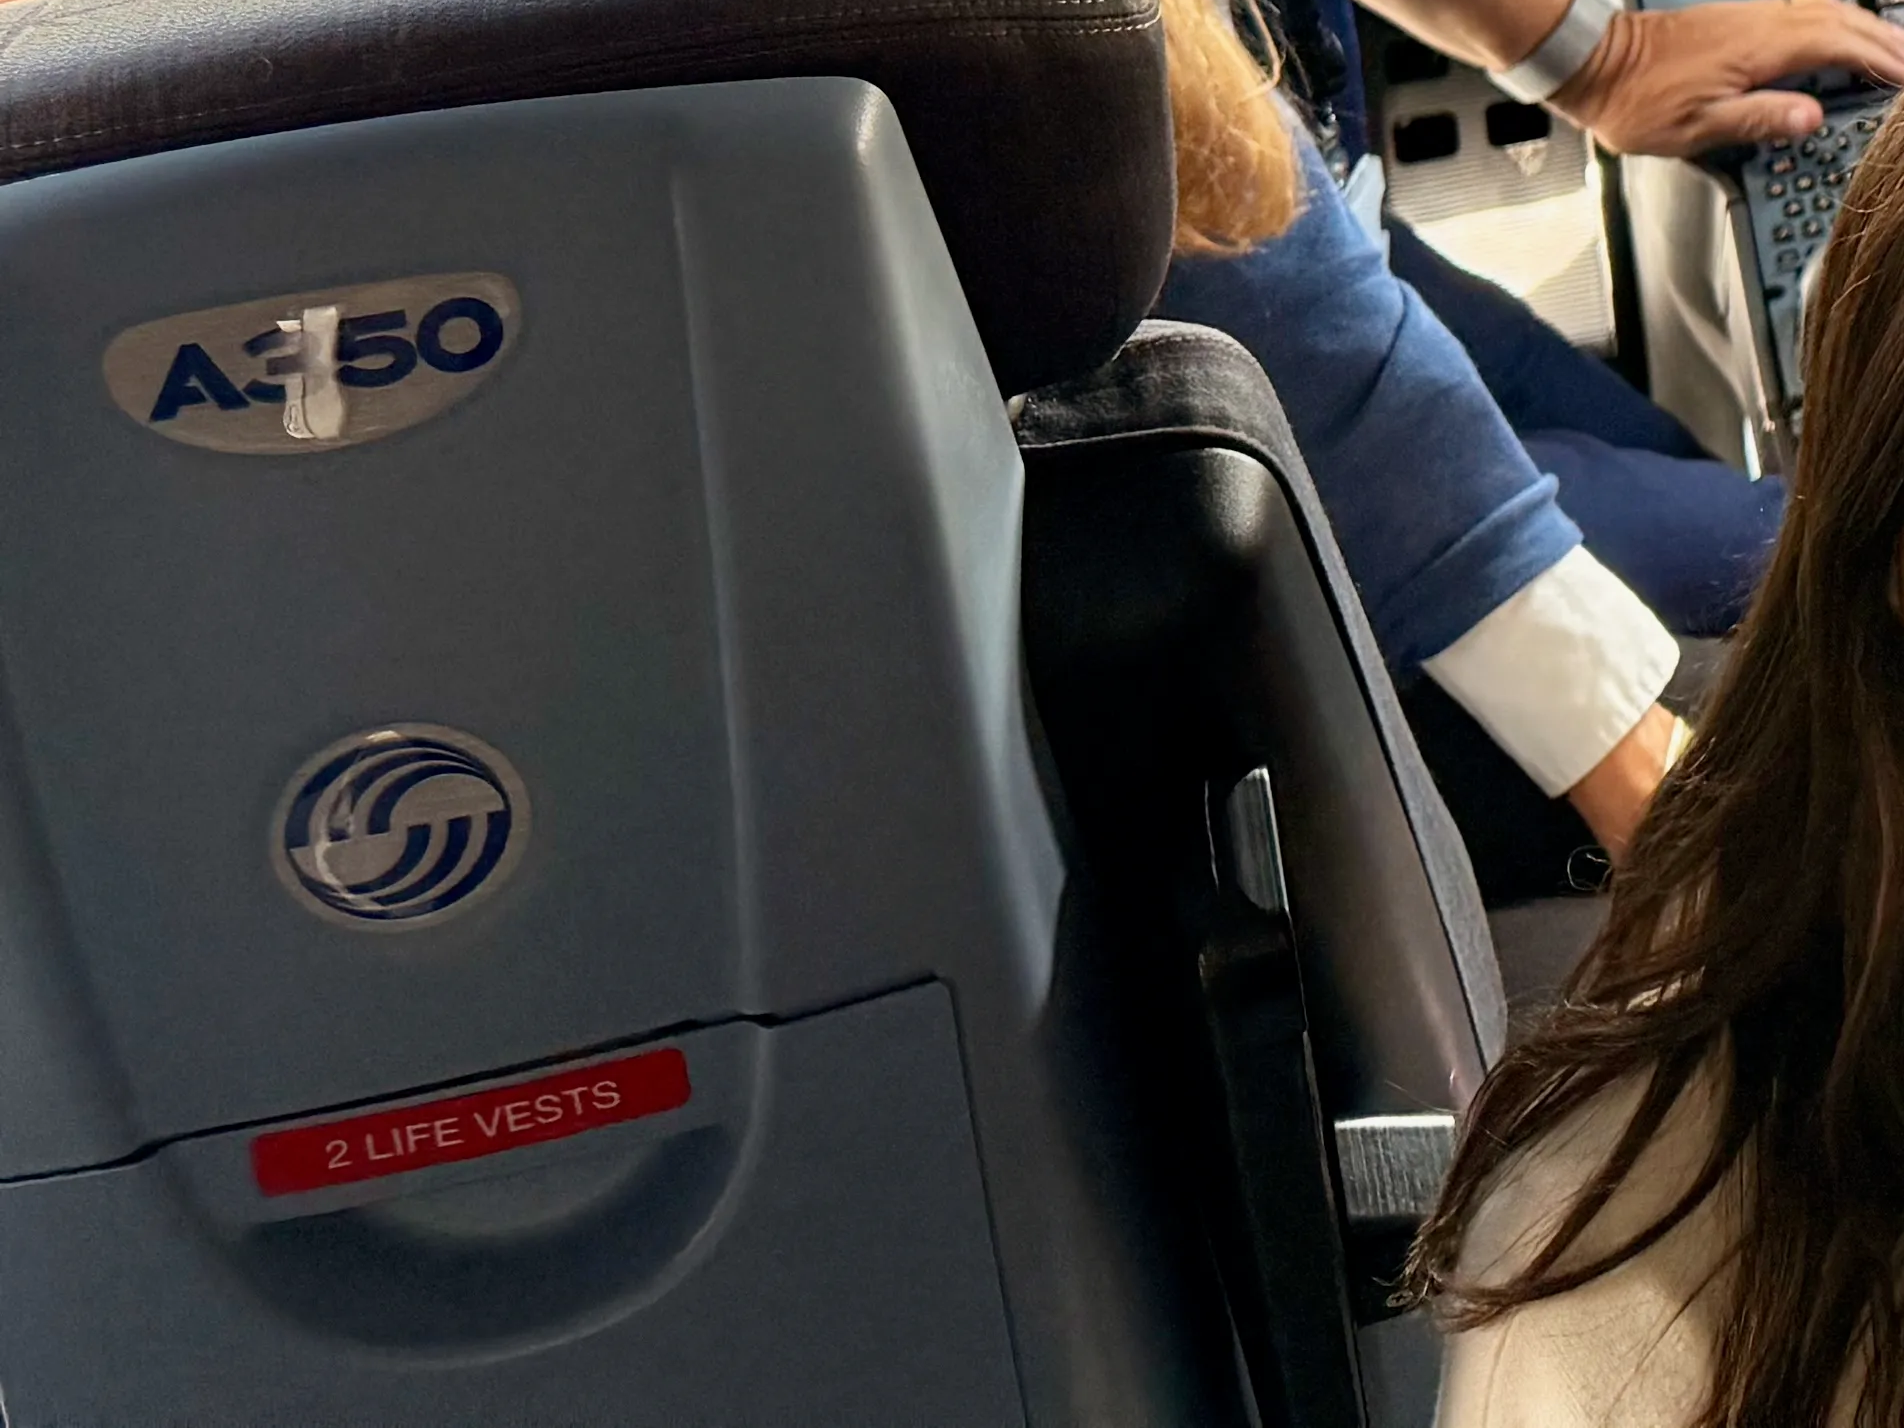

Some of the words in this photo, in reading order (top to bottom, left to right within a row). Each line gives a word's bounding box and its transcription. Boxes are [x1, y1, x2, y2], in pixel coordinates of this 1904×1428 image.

[325, 1138, 353, 1170] 2
[364, 1116, 465, 1162] LIFE
[472, 1079, 622, 1139] VESTS
